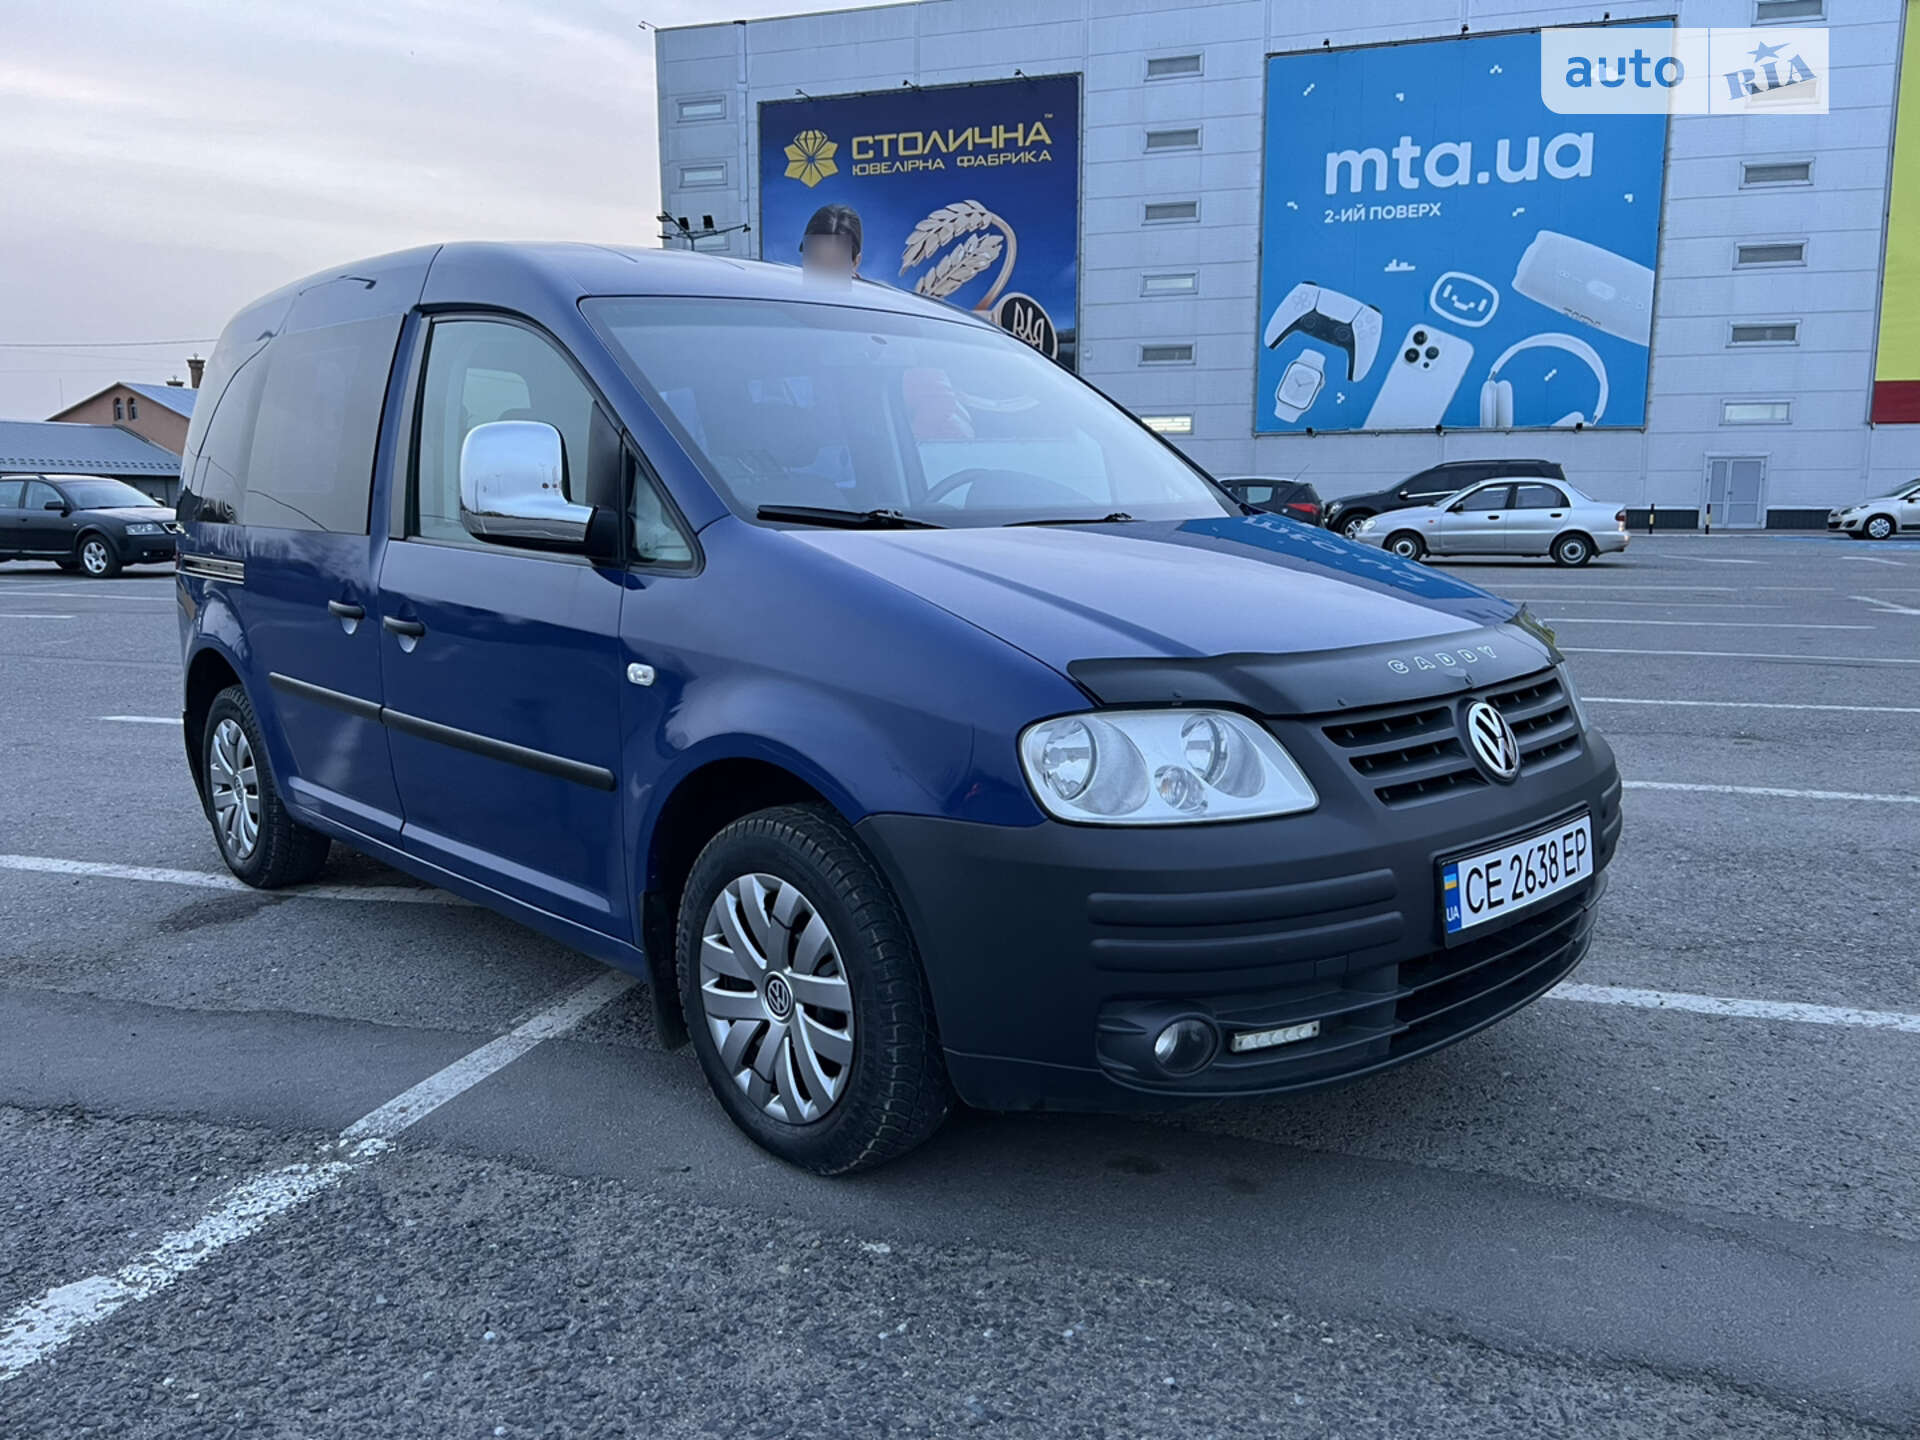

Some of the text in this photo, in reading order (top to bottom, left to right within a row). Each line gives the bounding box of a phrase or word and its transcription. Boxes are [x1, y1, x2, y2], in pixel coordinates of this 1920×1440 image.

[852, 121, 1053, 160] СТОЛИЧНА
[852, 150, 1052, 176] ЮВЕЛІРНА ФАБРИКА
[1325, 132, 1594, 195] mta.ua
[1324, 202, 1441, 224] 2-ИЙ ПОВЕРХ
[1387, 645, 1497, 674] CADDY
[1465, 827, 1587, 914] CE 2638 EP
[1446, 905, 1459, 922] UA
